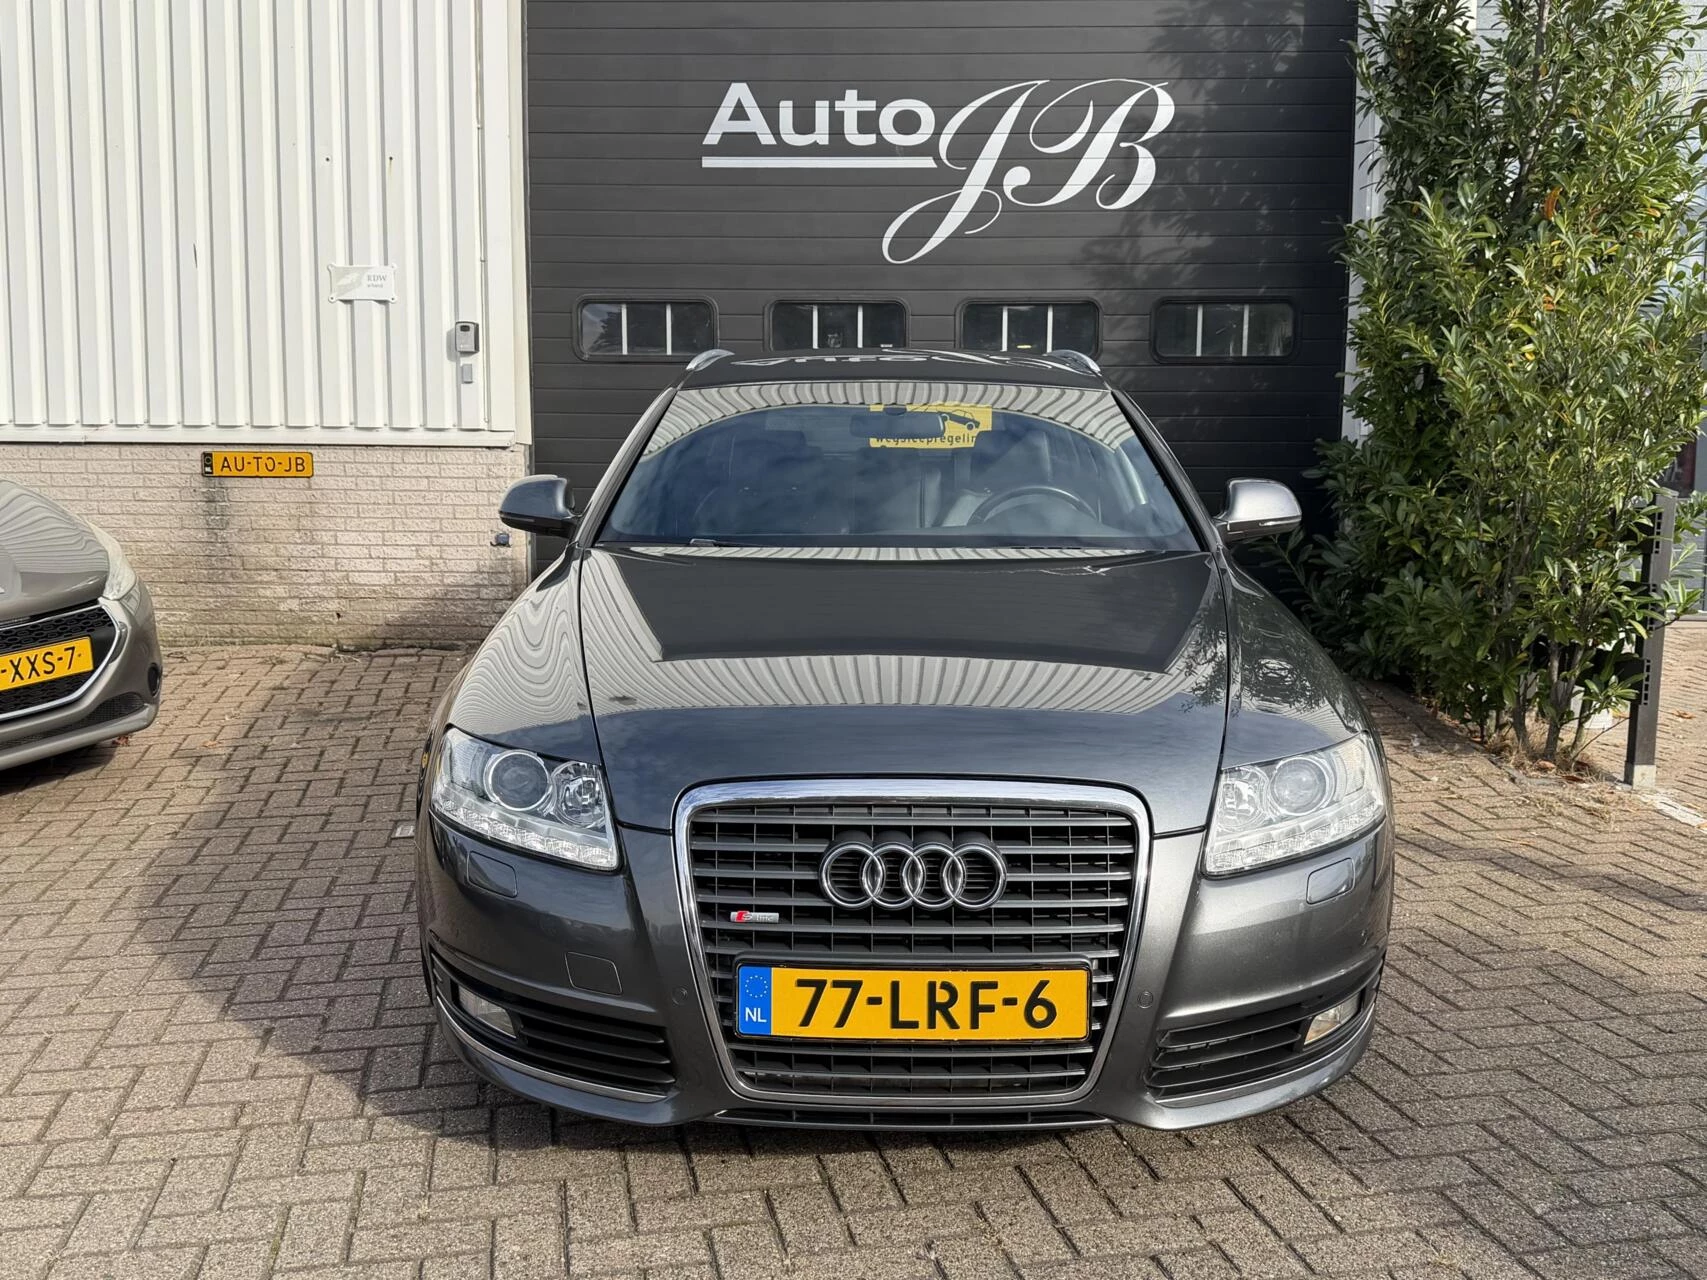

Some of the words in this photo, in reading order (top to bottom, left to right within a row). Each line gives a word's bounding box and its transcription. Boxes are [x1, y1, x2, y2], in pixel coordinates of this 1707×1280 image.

[702, 82, 936, 147] Auto
[882, 78, 1175, 264] JB
[220, 456, 306, 473] AU-TO-JB
[745, 1007, 767, 1023] NL
[795, 978, 1058, 1030] 77-LRF-6
